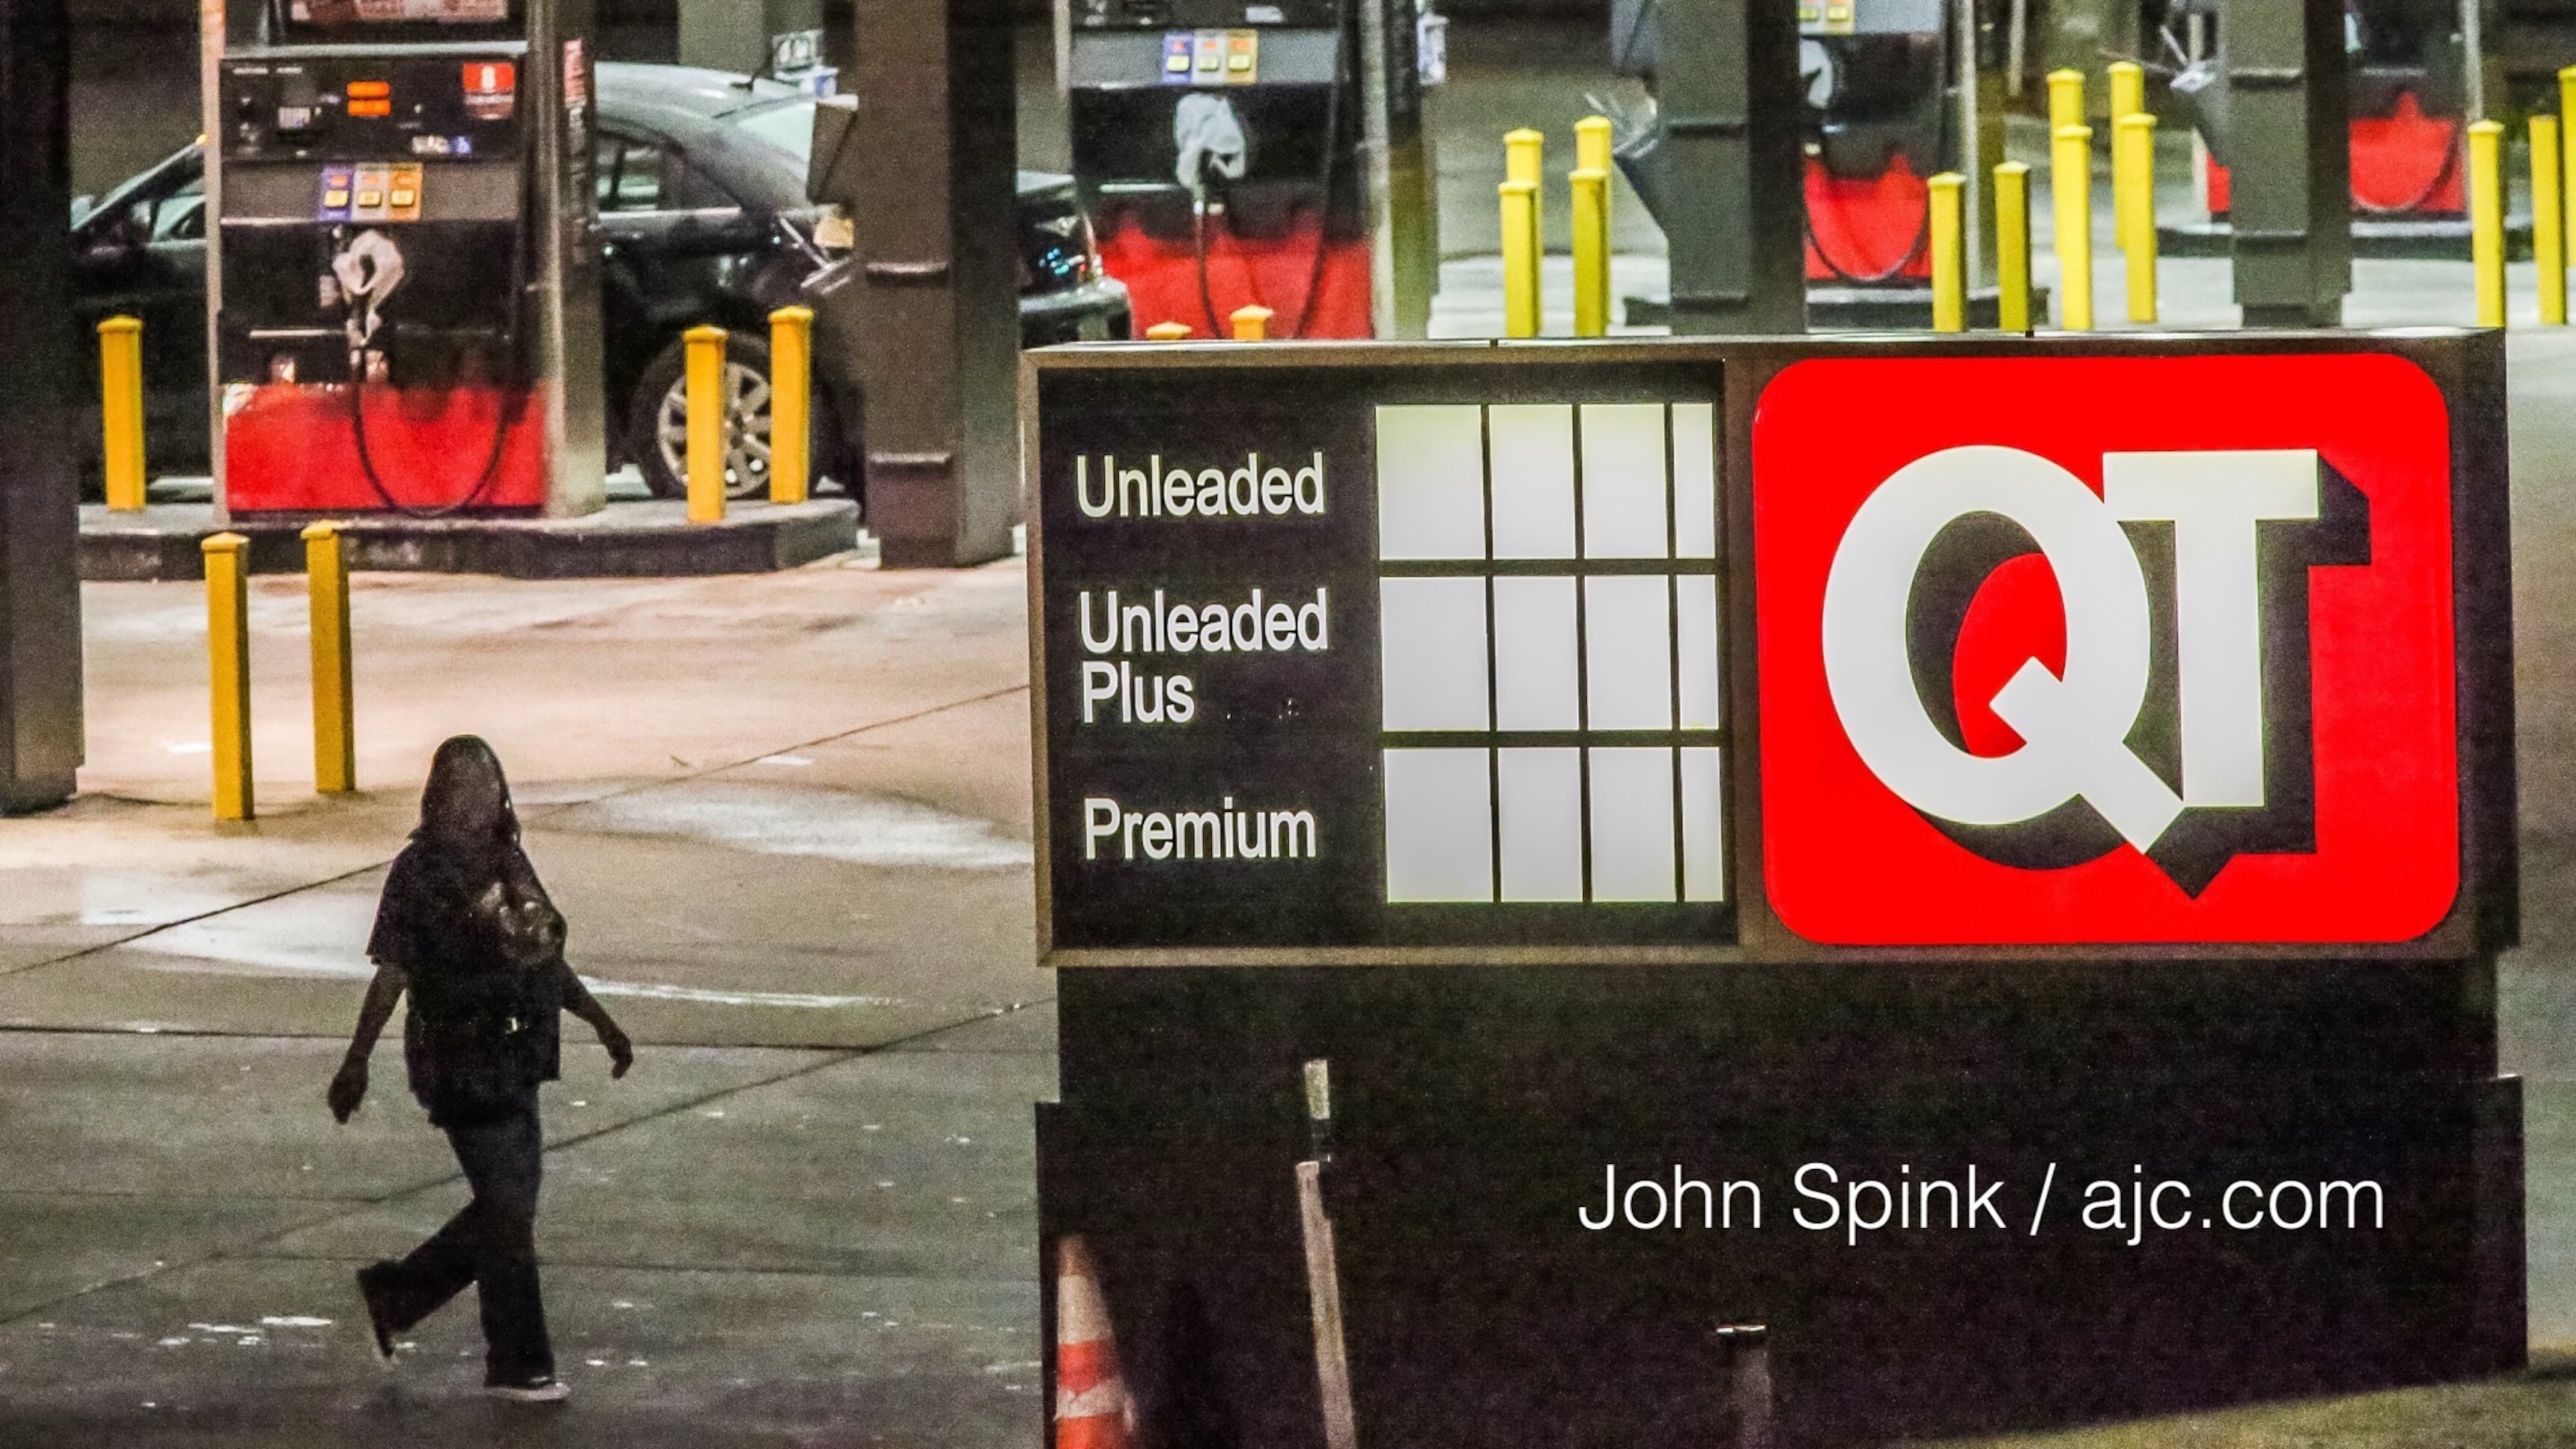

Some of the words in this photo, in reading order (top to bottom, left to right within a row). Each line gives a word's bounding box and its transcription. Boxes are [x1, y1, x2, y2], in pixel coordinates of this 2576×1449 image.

[1076, 451, 1326, 518] Unleaded
[1079, 586, 1328, 654] Unleaded
[1821, 445, 2320, 855] QT
[1081, 660, 1195, 723] Plus
[1083, 796, 1316, 861] Premium
